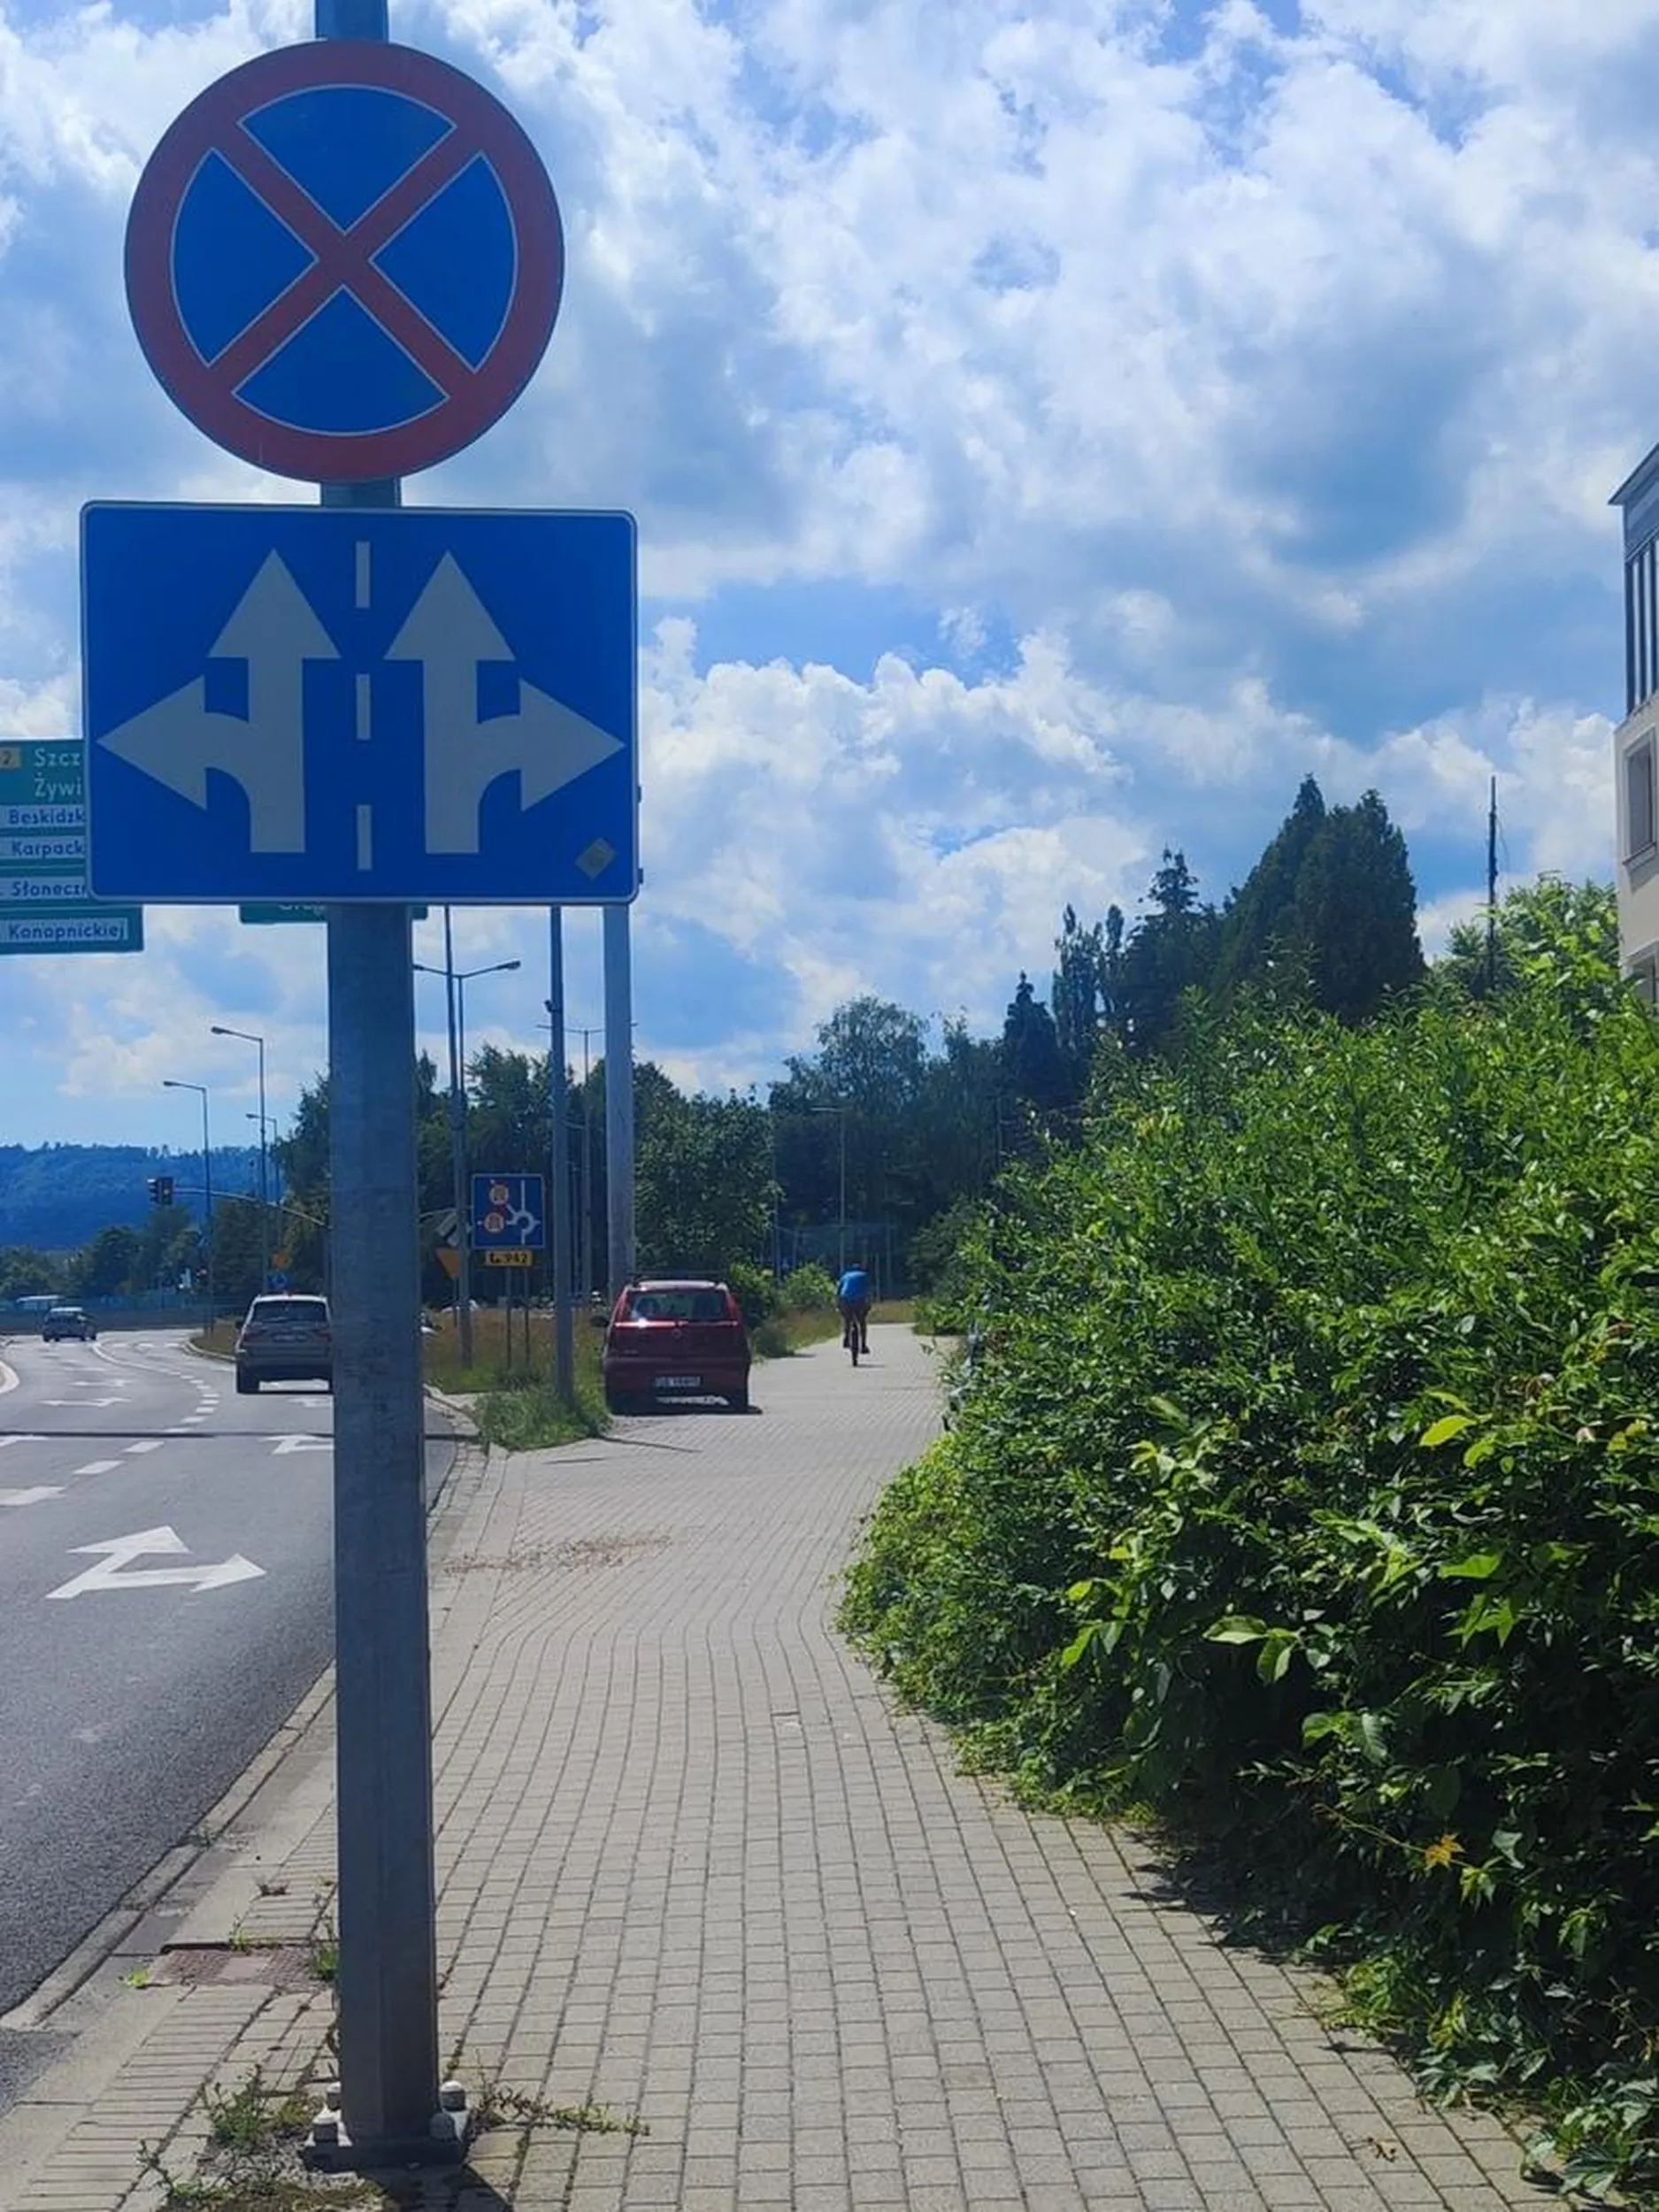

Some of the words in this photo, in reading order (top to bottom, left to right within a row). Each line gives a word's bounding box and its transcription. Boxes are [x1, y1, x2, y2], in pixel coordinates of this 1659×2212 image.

[35, 747, 81, 767] Szcz
[35, 771, 81, 802] Żywi
[9, 923, 125, 942] Konopnickiej
